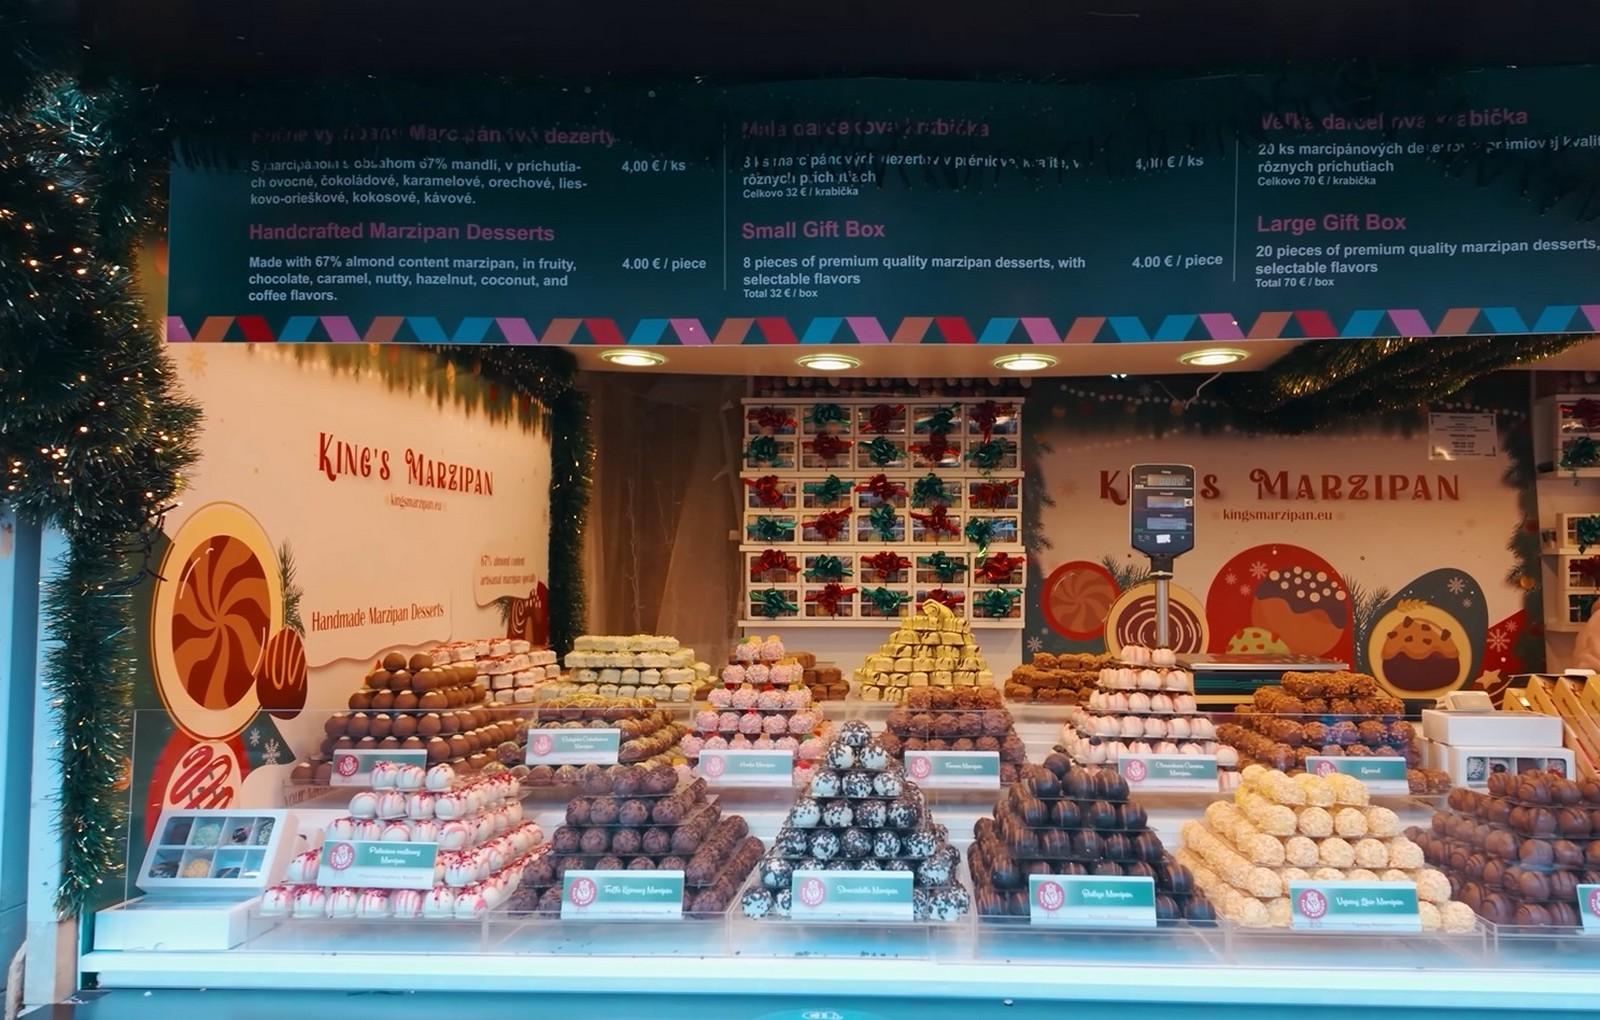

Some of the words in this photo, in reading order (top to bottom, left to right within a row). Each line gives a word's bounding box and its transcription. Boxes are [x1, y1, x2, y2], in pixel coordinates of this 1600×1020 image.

[544, 126, 615, 148] dezerty
[1259, 144, 1274, 155] 20
[1280, 143, 1294, 154] ks
[1299, 143, 1403, 157] marcipánových
[251, 160, 260, 172] S
[504, 161, 513, 171] v
[621, 160, 648, 173] 4,00
[652, 160, 660, 171] €
[662, 160, 668, 171] /
[671, 160, 686, 171] ks
[943, 156, 951, 165] v
[1167, 156, 1175, 168] €
[1178, 156, 1183, 167] /
[1188, 155, 1204, 167] ks
[1258, 161, 1313, 175] rôznych
[1318, 160, 1394, 174] príchutiach
[250, 178, 265, 188] ch
[269, 176, 317, 189] ovocné,
[321, 174, 399, 188] čokoládové,
[403, 176, 485, 189] karamelové,
[489, 178, 555, 190] orechové,
[560, 177, 587, 189] lies-
[1257, 177, 1300, 186] Celkovo
[1304, 177, 1315, 185] 70
[1318, 176, 1324, 185] €
[1326, 176, 1330, 185] /
[1333, 176, 1376, 185] krabička
[250, 192, 349, 205] kovo-orieškové,
[352, 192, 420, 205] kokosové,
[424, 192, 476, 204] kávové.
[743, 189, 783, 199] Celkovo
[786, 188, 798, 197] 32
[800, 188, 807, 197] €
[809, 188, 813, 197] /
[815, 187, 859, 197] krabička
[742, 222, 796, 239] Small
[803, 221, 839, 238] Gift
[846, 221, 885, 238] Box
[1257, 216, 1316, 235] Large
[1323, 214, 1359, 230] Gift
[1366, 214, 1406, 230] Box
[249, 222, 363, 240] Handcrafted
[368, 222, 459, 243] Marzipan
[466, 224, 555, 241] Desserts
[1256, 245, 1272, 257] 20
[1277, 245, 1322, 259] pieces
[1326, 244, 1340, 256] of
[1344, 244, 1405, 258] premium
[1409, 242, 1457, 256] quality
[1462, 241, 1528, 254] marzipan
[250, 256, 282, 268] Made
[286, 256, 312, 268] with
[315, 256, 342, 268] 67%
[346, 256, 394, 268] almond
[398, 257, 449, 268] content
[453, 258, 518, 271] marzipan,
[523, 258, 534, 269] in
[538, 258, 576, 272] fruity,
[622, 258, 649, 269] 4.00
[652, 258, 660, 269] €
[663, 258, 668, 269] /
[672, 258, 706, 272] piece
[744, 257, 750, 268] 8
[755, 257, 797, 270] pieces
[801, 256, 816, 267] of
[819, 257, 878, 269] premium
[883, 256, 927, 270] quality
[932, 257, 991, 270] marzipan
[995, 257, 1054, 269] desserts,
[1058, 257, 1085, 268] with
[1132, 256, 1161, 268] 4.00
[1164, 255, 1173, 267] €
[1176, 255, 1182, 267] /
[1185, 254, 1223, 269] piece
[1256, 262, 1326, 274] selectable
[1330, 262, 1378, 273] flavors
[248, 274, 313, 286] chocolate,
[317, 273, 372, 286] caramel,
[376, 274, 412, 286] nutty,
[416, 274, 477, 287] hazelnut,
[481, 276, 539, 287] coconut,
[544, 275, 568, 286] and
[744, 274, 810, 285] selectable
[814, 273, 860, 284] flavors
[1256, 278, 1281, 287] Total
[1284, 278, 1297, 287] 70
[1299, 277, 1306, 286] €
[1308, 277, 1312, 286] /
[1314, 277, 1334, 286] box
[248, 290, 286, 301] coffee
[290, 290, 337, 301] flavors.
[744, 289, 767, 298] Total
[770, 289, 781, 297] 32
[784, 289, 791, 297] €
[792, 289, 797, 297] /
[799, 289, 817, 297] box
[319, 432, 390, 481] KING'S
[405, 448, 493, 496] MARZIPAN
[1249, 468, 1460, 501] MARZIPAN
[1222, 508, 1332, 522] kingsmarzipan.eu
[312, 608, 365, 632] Handmade
[369, 606, 408, 625] Marzipan
[411, 603, 444, 619] Desserts
